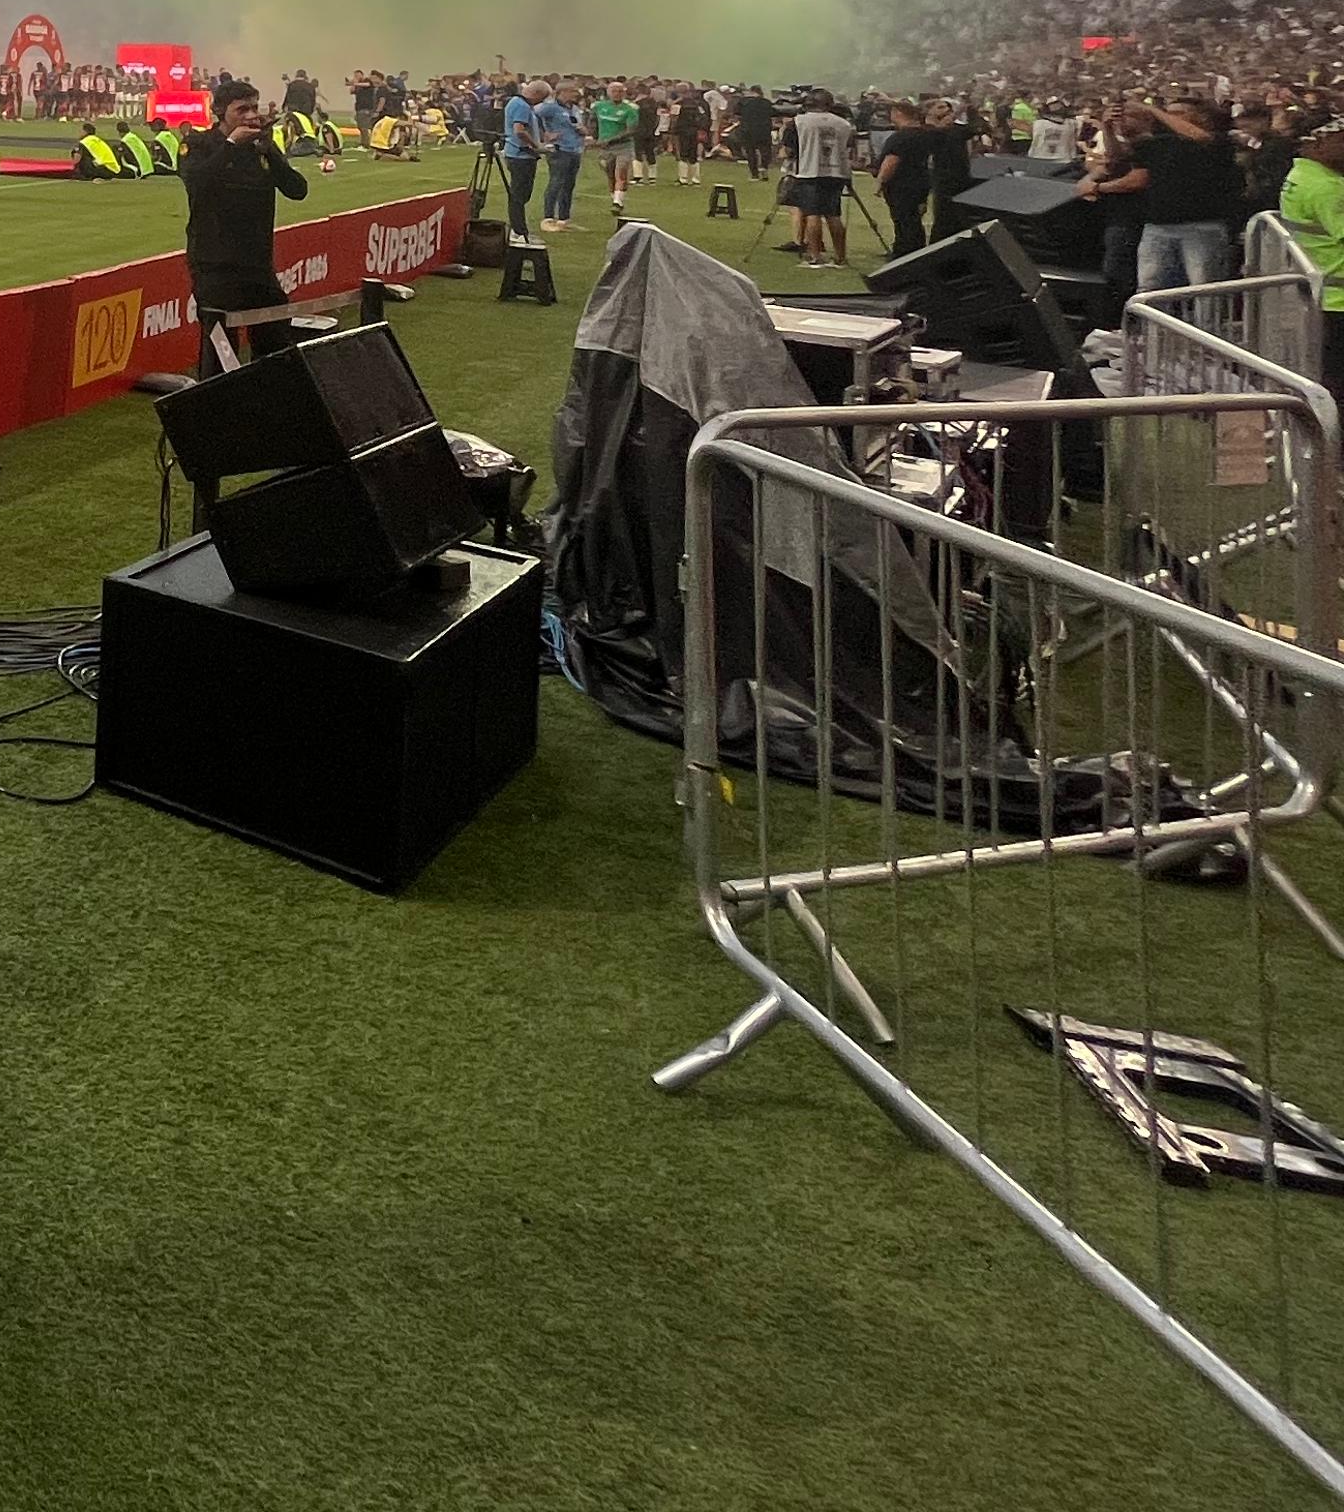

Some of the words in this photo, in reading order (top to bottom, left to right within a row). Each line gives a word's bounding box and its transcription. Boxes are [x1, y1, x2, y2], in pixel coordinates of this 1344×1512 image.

[365, 207, 445, 275] SUPERBET
[80, 300, 128, 373] 120
[142, 298, 181, 339] FINAL
